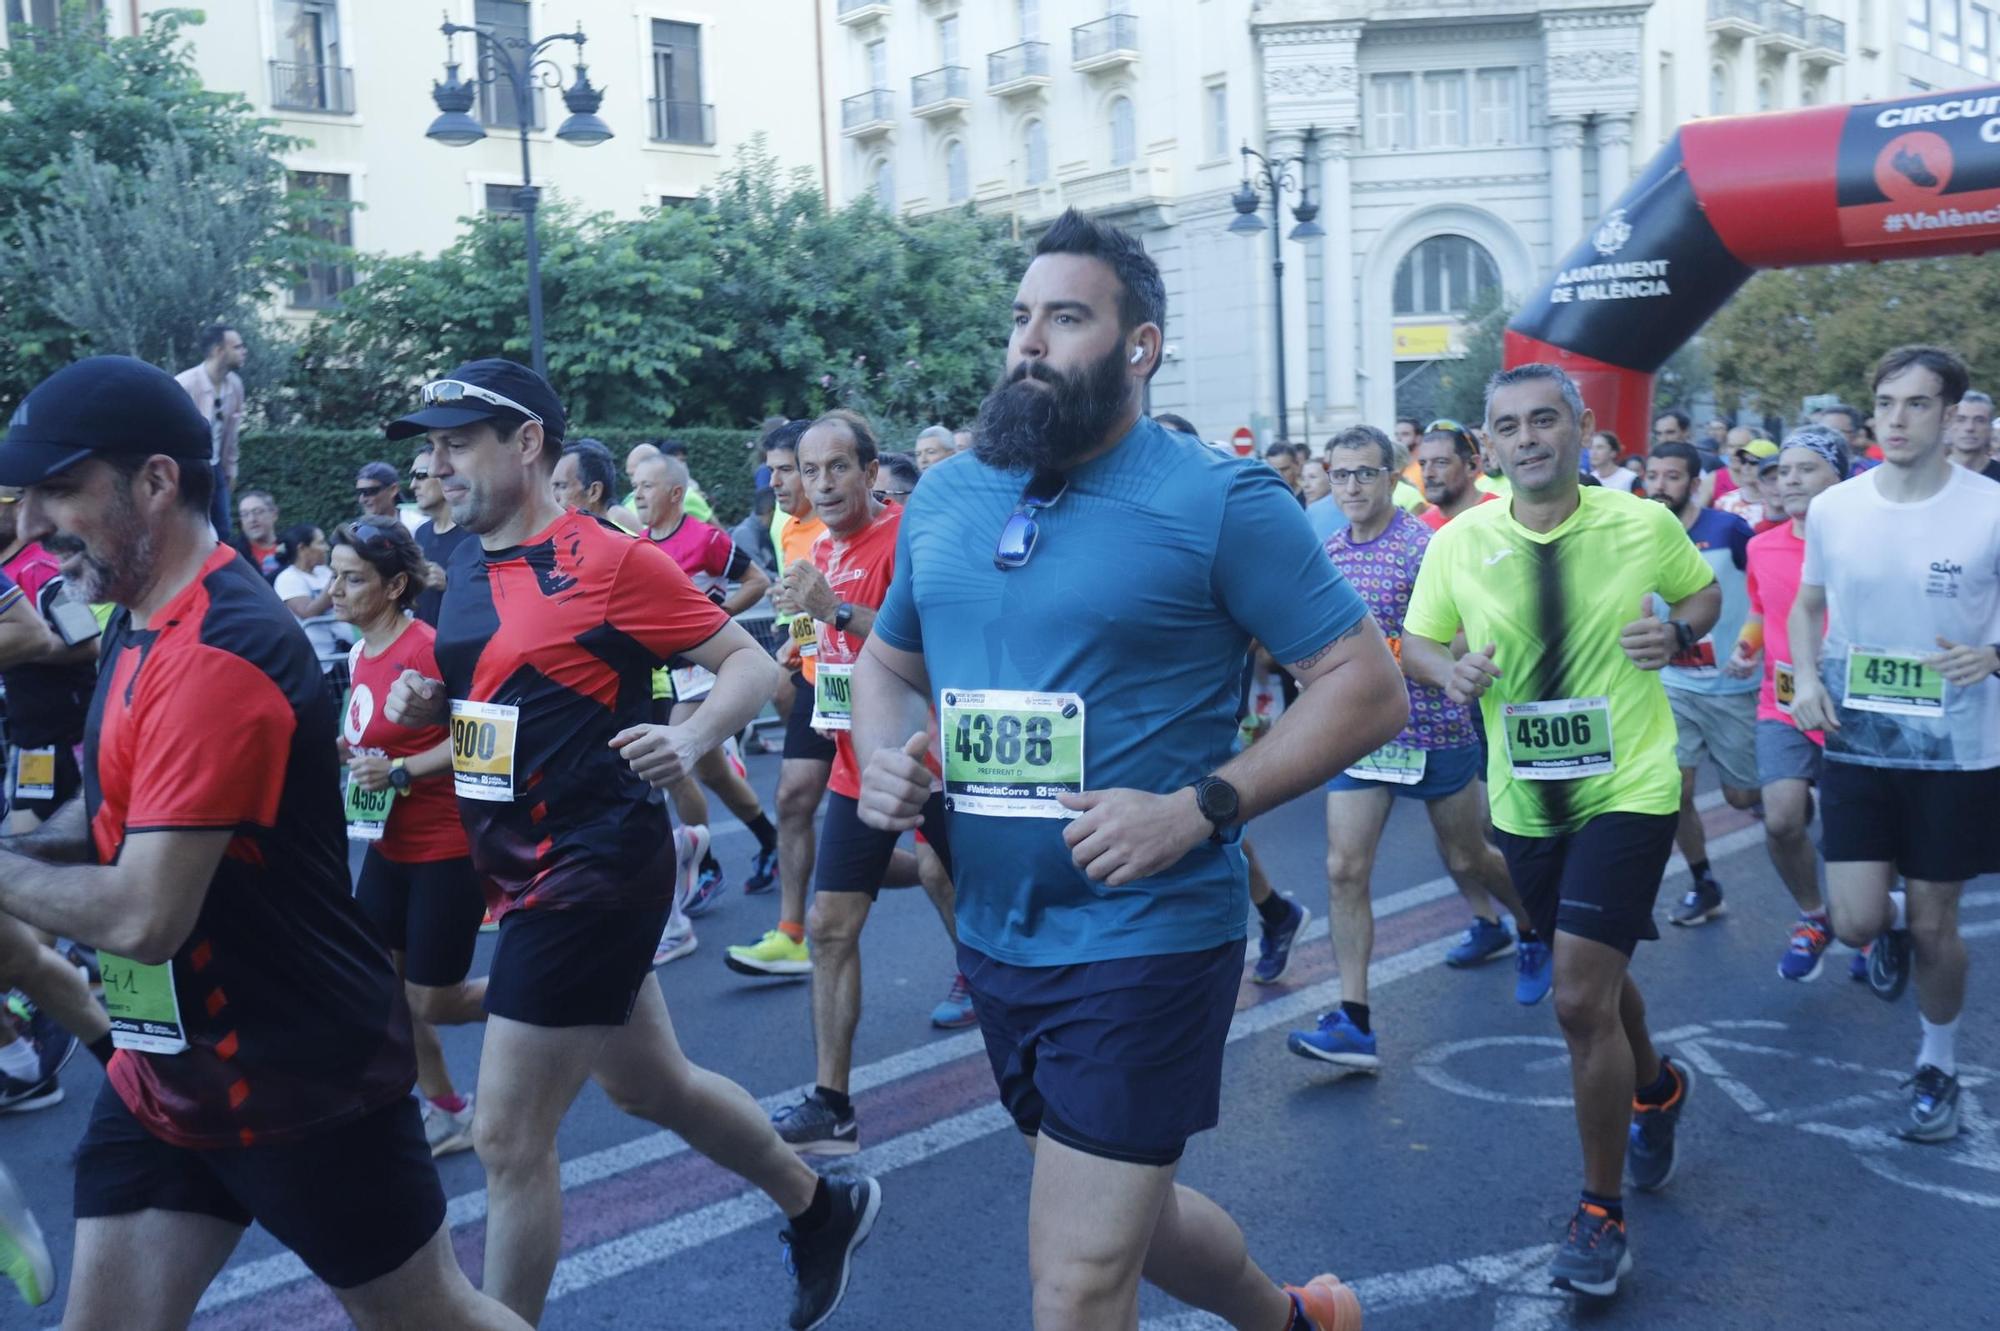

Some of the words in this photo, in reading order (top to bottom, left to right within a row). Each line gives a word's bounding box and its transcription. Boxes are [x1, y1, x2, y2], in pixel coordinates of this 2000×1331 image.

[1876, 96, 2000, 128] CIRCUI
[1555, 259, 1671, 286] AJUNTAMENT
[1550, 286, 1573, 303] DE
[1577, 280, 1671, 301] VALÈNCIA
[1864, 658, 1923, 688] 4311
[955, 714, 1053, 766] 4388
[1517, 714, 1591, 749] 4306
[977, 767, 1014, 776] PREFERENT
